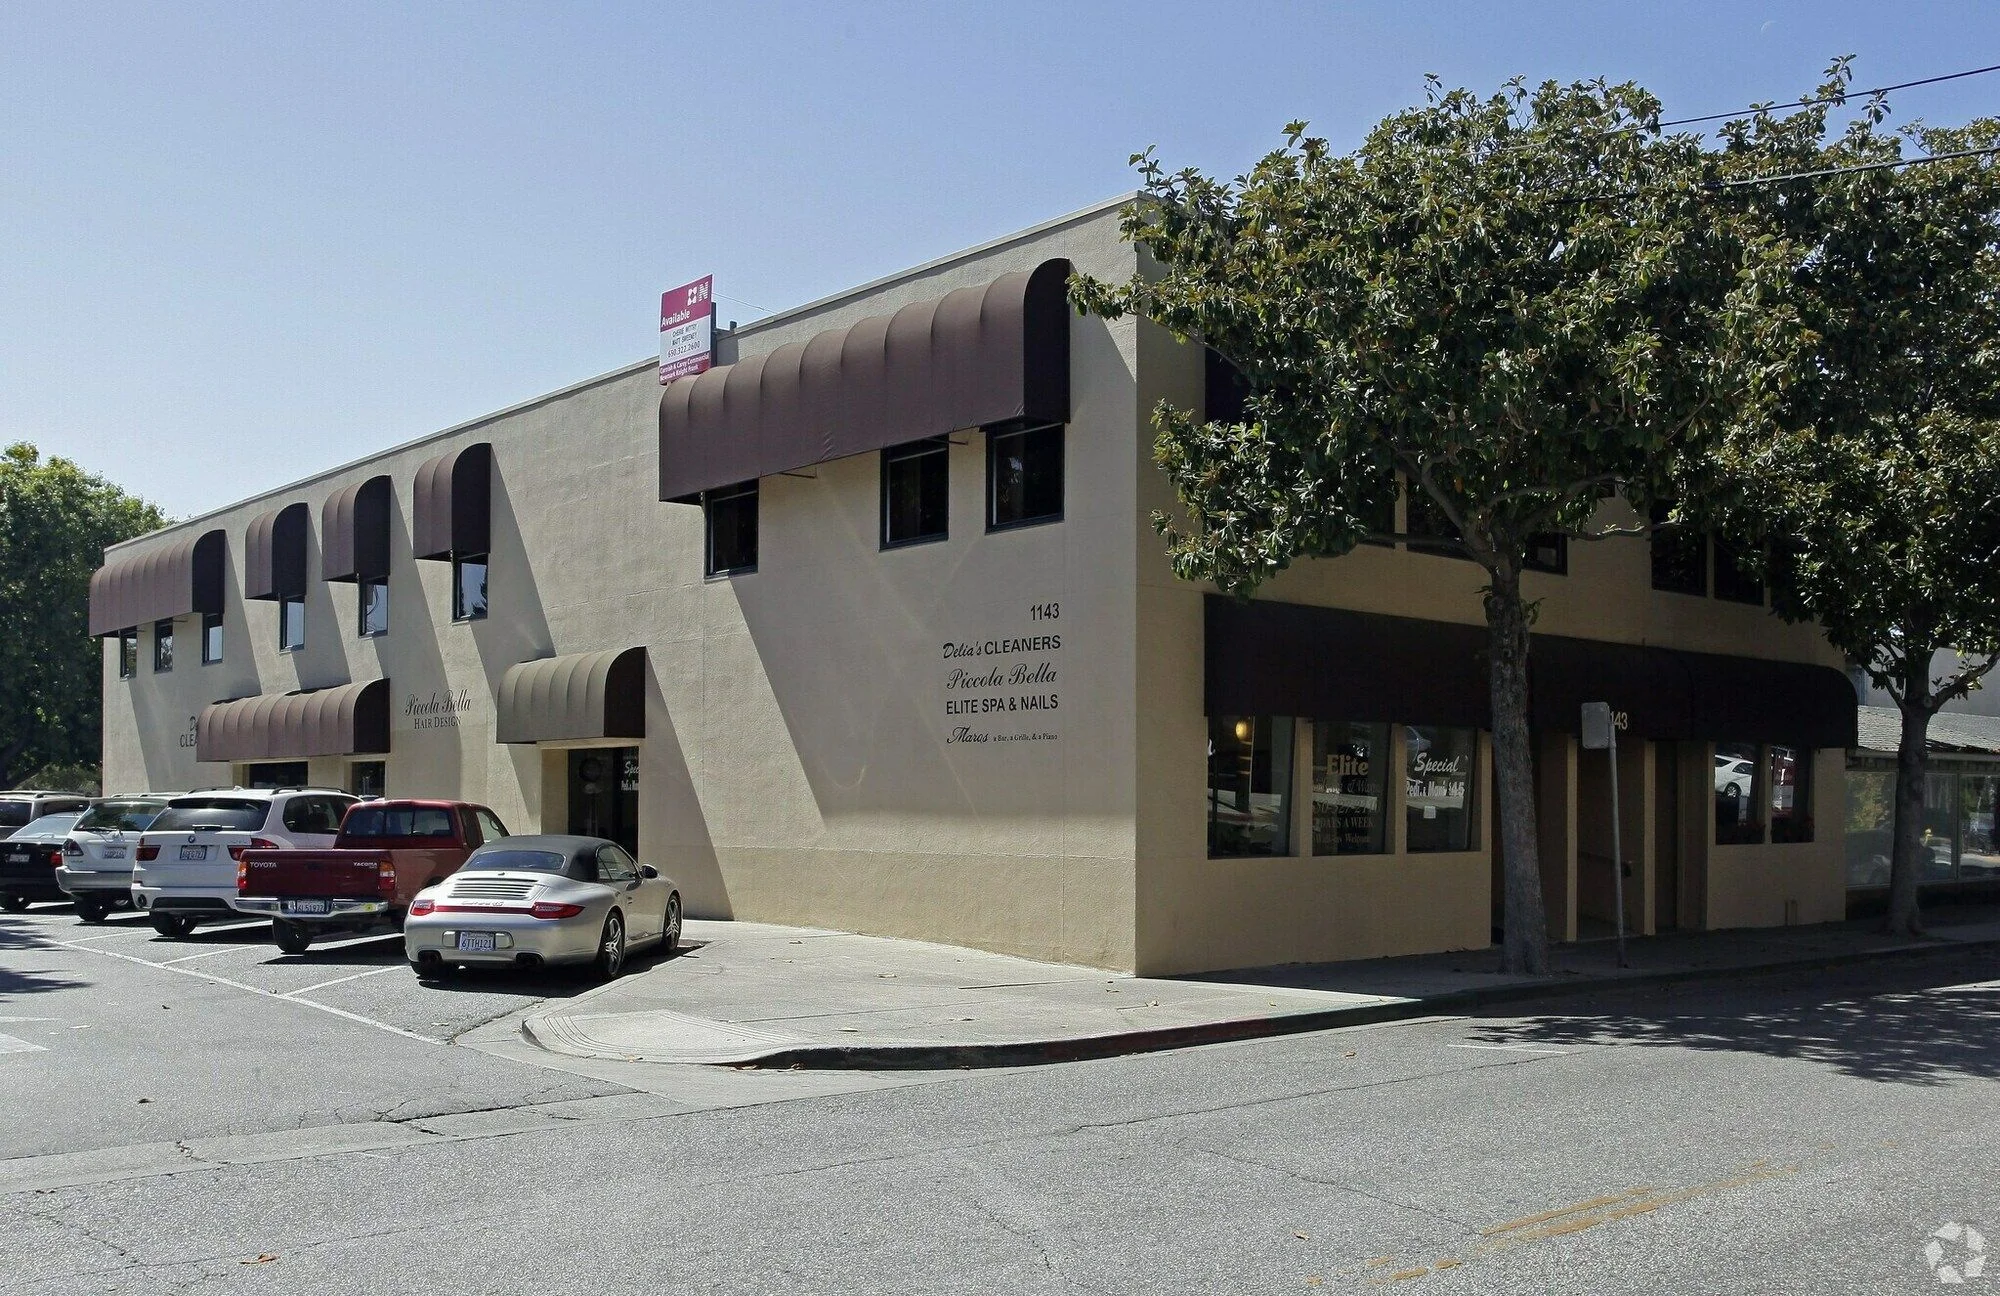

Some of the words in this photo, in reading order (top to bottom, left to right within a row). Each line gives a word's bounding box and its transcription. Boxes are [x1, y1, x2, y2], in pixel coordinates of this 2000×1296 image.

[661, 309, 691, 327] Available
[1030, 603, 1060, 620] 1143
[943, 641, 981, 659] Delia's
[984, 635, 1061, 655] CLEANERS
[946, 666, 1003, 689] Piccola
[1008, 662, 1057, 684] Bella
[404, 693, 440, 716] Piccola
[441, 688, 472, 713] Bella
[946, 700, 978, 715] ELITE
[982, 698, 1005, 713] SPA
[1008, 696, 1017, 711] &
[1020, 694, 1059, 710] NAILS
[414, 718, 433, 730] HAIR
[434, 715, 462, 728] DESIGN
[1326, 754, 1369, 776] Elite
[1413, 752, 1460, 777] Special
